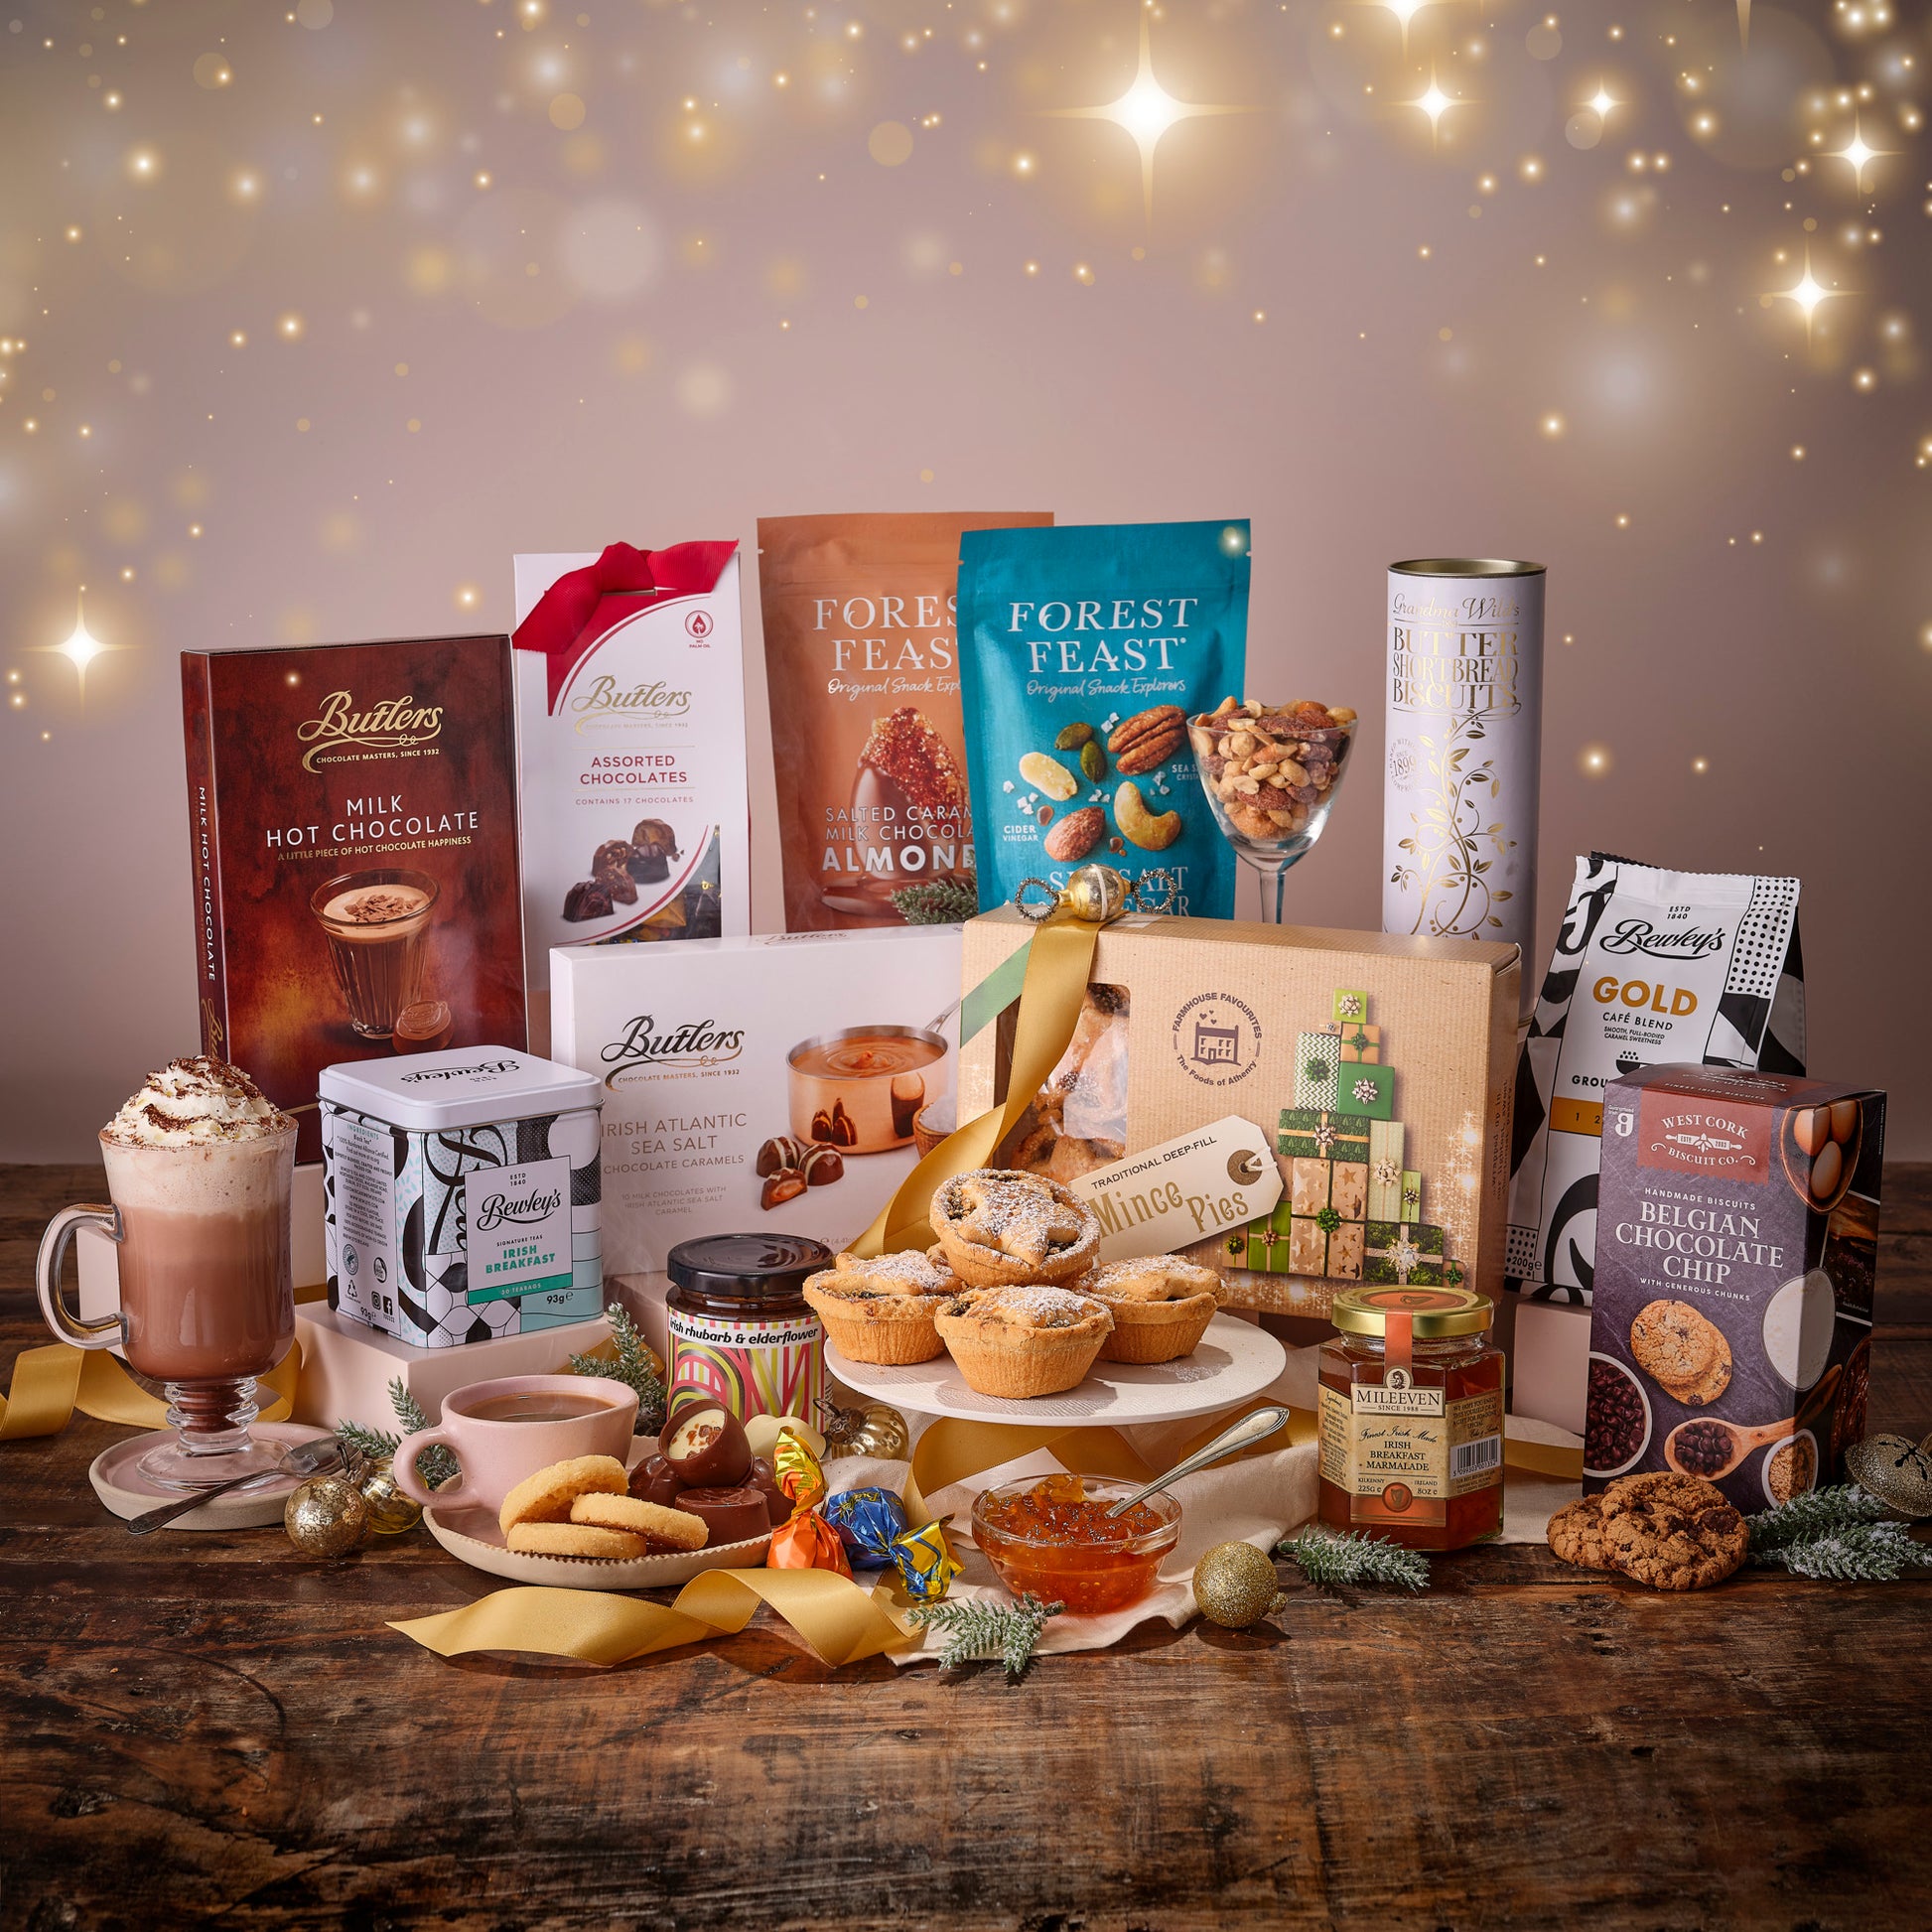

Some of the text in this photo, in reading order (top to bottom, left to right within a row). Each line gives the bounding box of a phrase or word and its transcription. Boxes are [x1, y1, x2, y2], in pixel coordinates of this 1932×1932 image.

[813, 596, 957, 630] FORES
[1007, 598, 1197, 632] FOREST
[1394, 626, 1518, 656] BUTTER
[831, 637, 959, 671] FEAS
[1027, 637, 1181, 673] FEAST
[1394, 652, 1518, 686] SHORTBREAD
[572, 675, 692, 717] Butlers
[828, 677, 890, 701] Original
[893, 676, 934, 694] Snack
[1027, 677, 1185, 703] Original Snack Explorers
[1394, 678, 1519, 709] BISCUITS
[298, 690, 443, 747] Butlers
[316, 754, 360, 764] CHOCOLATE
[362, 752, 398, 761] MASTERS,
[591, 756, 675, 767] ASSORTED
[1172, 763, 1189, 772] SEA
[580, 771, 687, 784] CHOCOLATES
[346, 794, 403, 816] MILK
[826, 805, 972, 822] SALTED CARAM
[267, 811, 479, 848] HOT CHOCOLATE
[826, 824, 975, 841] MILK CHOCOLA
[1004, 825, 1036, 834] CIDER
[315, 848, 339, 858] PIECE
[341, 847, 352, 856] OF
[354, 845, 373, 855] HOT
[375, 840, 427, 853] CHOCOLATE
[428, 835, 472, 847] HAPPINESS
[199, 787, 207, 826] MILK
[204, 877, 215, 981] CHOCOLATE
[1599, 918, 1725, 960] Bewley's
[1592, 976, 1698, 1017] GOLD
[1173, 993, 1262, 1038] FARMHOUSE FAVOURITES
[1602, 1012, 1673, 1031] CAFÉ BLEND
[601, 1014, 745, 1066] Butlers
[1604, 1033, 1628, 1041] CARAMEL
[619, 1074, 660, 1083] CHOCOLATE
[1177, 1053, 1188, 1070] The
[1189, 1069, 1214, 1085] Foods
[1228, 1060, 1257, 1084] Athenry
[1572, 1074, 1608, 1088] GROU
[601, 1113, 747, 1137] IRISH ATLANTIC
[1594, 1115, 1600, 1124] 2
[1661, 1114, 1748, 1140] WEST CORK
[631, 1135, 718, 1155] SEA SALT
[1668, 1147, 1716, 1166] BISCUIT
[604, 1155, 745, 1173] CHOCOLATE CARAMELS
[1091, 1136, 1217, 1189] TRADITIONAL DEEP-FILL
[647, 1198, 684, 1207] ATLANTIC
[653, 1187, 704, 1198] CHOCOLATES
[1644, 1187, 1756, 1211] HANDMADE BISCUITS
[477, 1188, 561, 1231] Bewley's
[655, 1206, 692, 1215] CARAMEL
[1086, 1181, 1183, 1238] Mince
[1185, 1191, 1249, 1233] Pies
[1639, 1201, 1761, 1239] BELGIAN
[496, 1237, 528, 1247] SIGNATURE
[503, 1245, 537, 1259] IRISH
[1615, 1222, 1784, 1269] CHOCOLATE
[485, 1253, 555, 1274] BREAKFAST
[1663, 1256, 1731, 1285] CHIP
[547, 1295, 565, 1305] 93g
[1640, 1278, 1750, 1302] WITH GENEROUS CHUNKS
[685, 1326, 732, 1343] rhubarb
[735, 1333, 746, 1343] &
[749, 1327, 818, 1344] elderflower
[1356, 1390, 1441, 1406] MILEEVEN
[1359, 1426, 1438, 1444] Finest Irish Made
[1384, 1441, 1411, 1449] IRISH
[1366, 1460, 1430, 1471] MARMALADE
[1370, 1450, 1426, 1460] BREAKFAST
